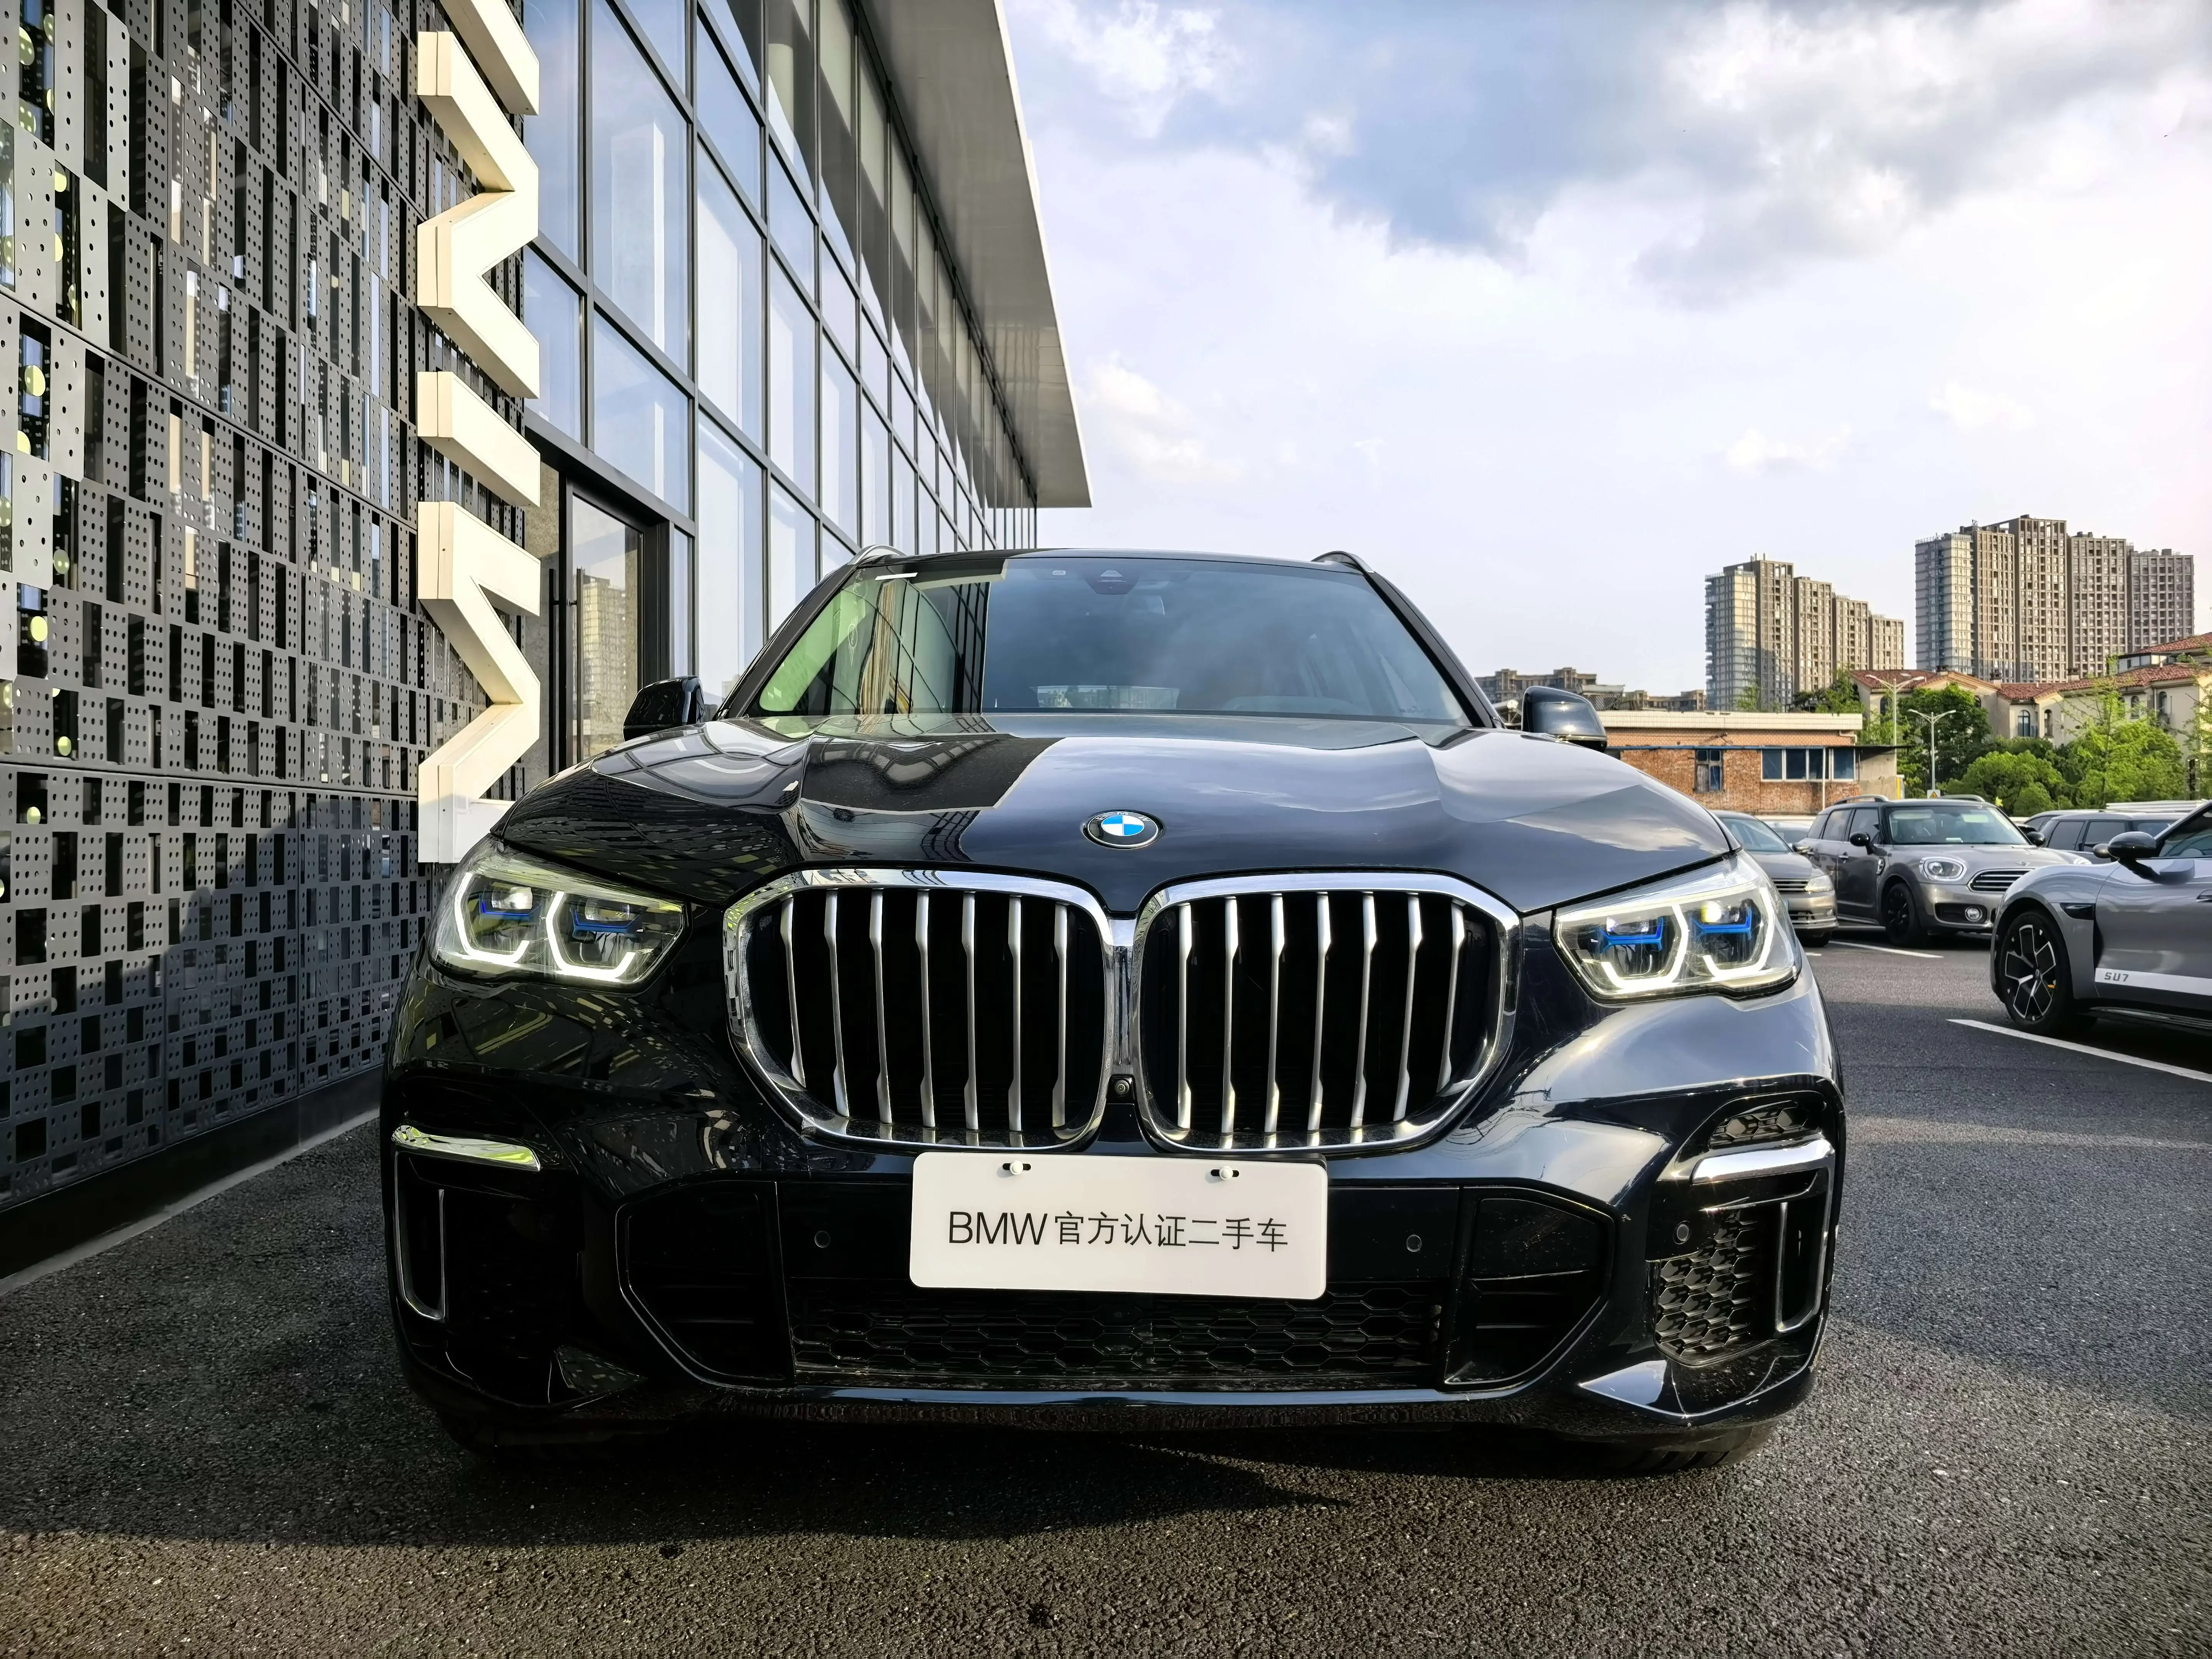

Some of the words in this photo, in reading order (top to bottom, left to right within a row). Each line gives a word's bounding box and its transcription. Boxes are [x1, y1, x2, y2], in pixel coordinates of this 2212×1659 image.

[2104, 972, 2129, 982] SU7
[949, 1211, 1048, 1245] BMW
[1055, 1210, 1288, 1252] 官方认证二手车
